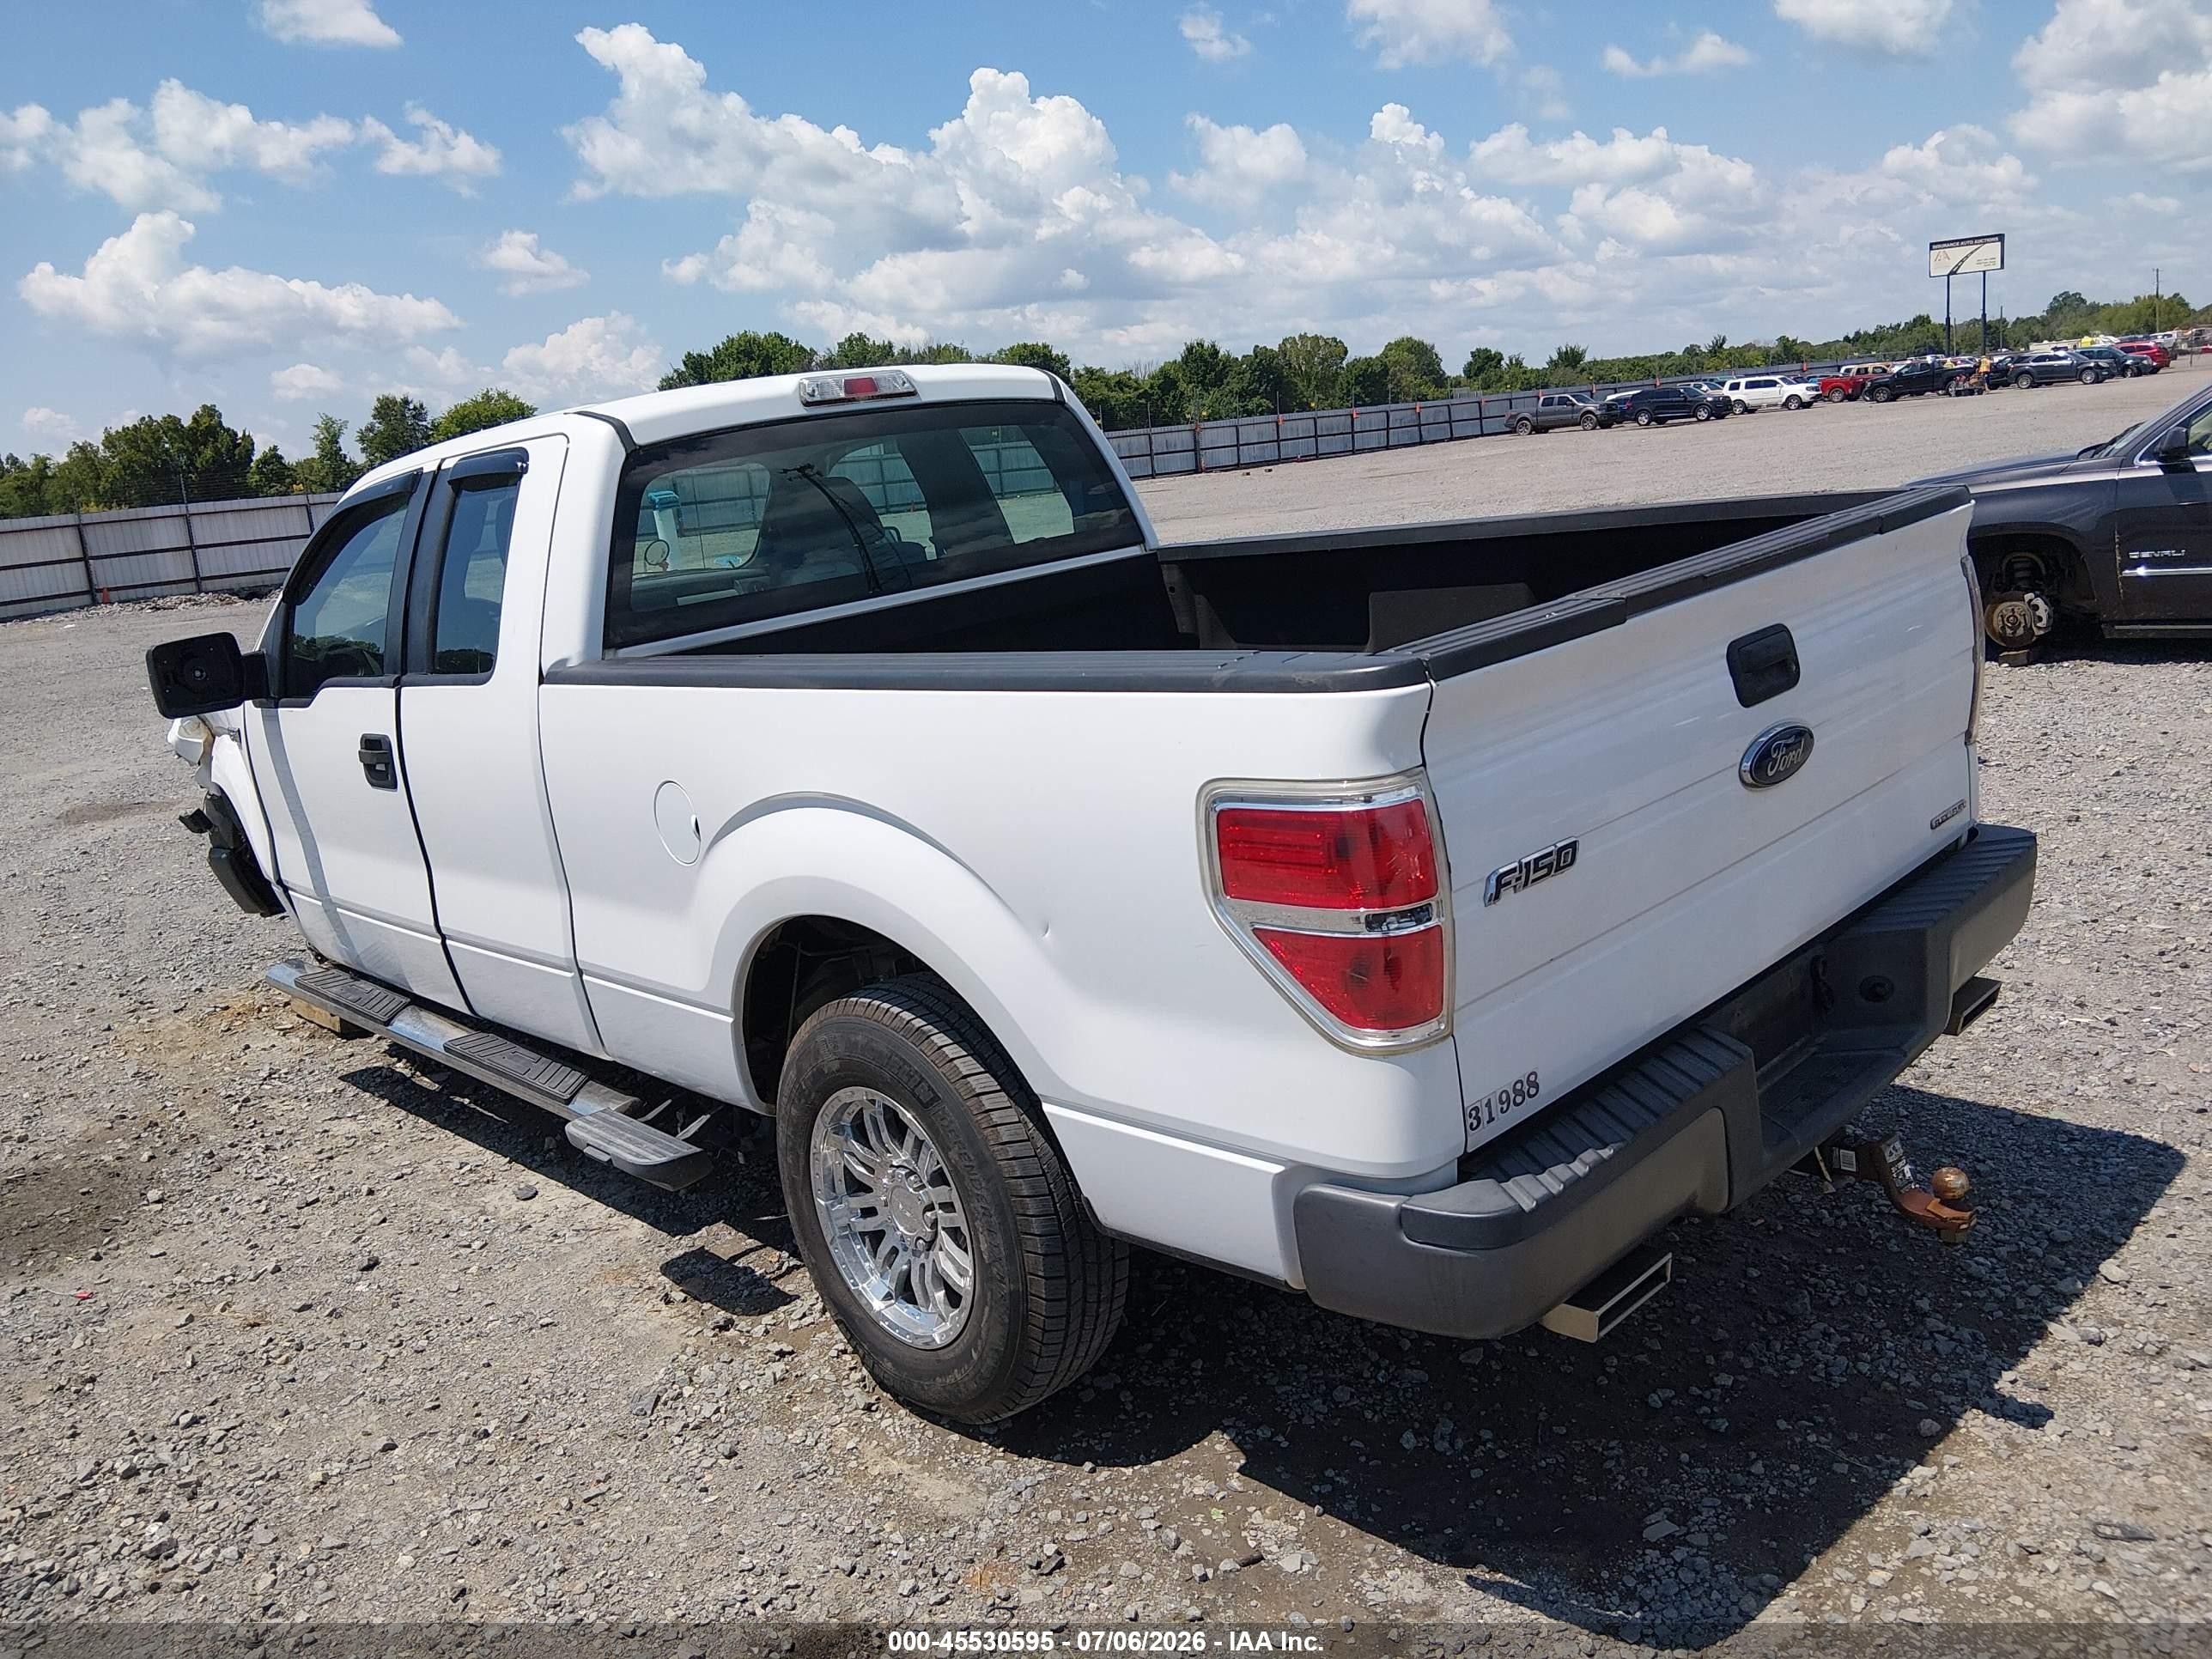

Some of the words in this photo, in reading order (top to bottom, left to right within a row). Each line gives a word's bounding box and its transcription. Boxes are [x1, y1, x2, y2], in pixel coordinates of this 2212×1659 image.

[2129, 550, 2185, 559] DENALI
[1767, 734, 1805, 776] Ford
[1468, 1071, 1540, 1131] 31988
